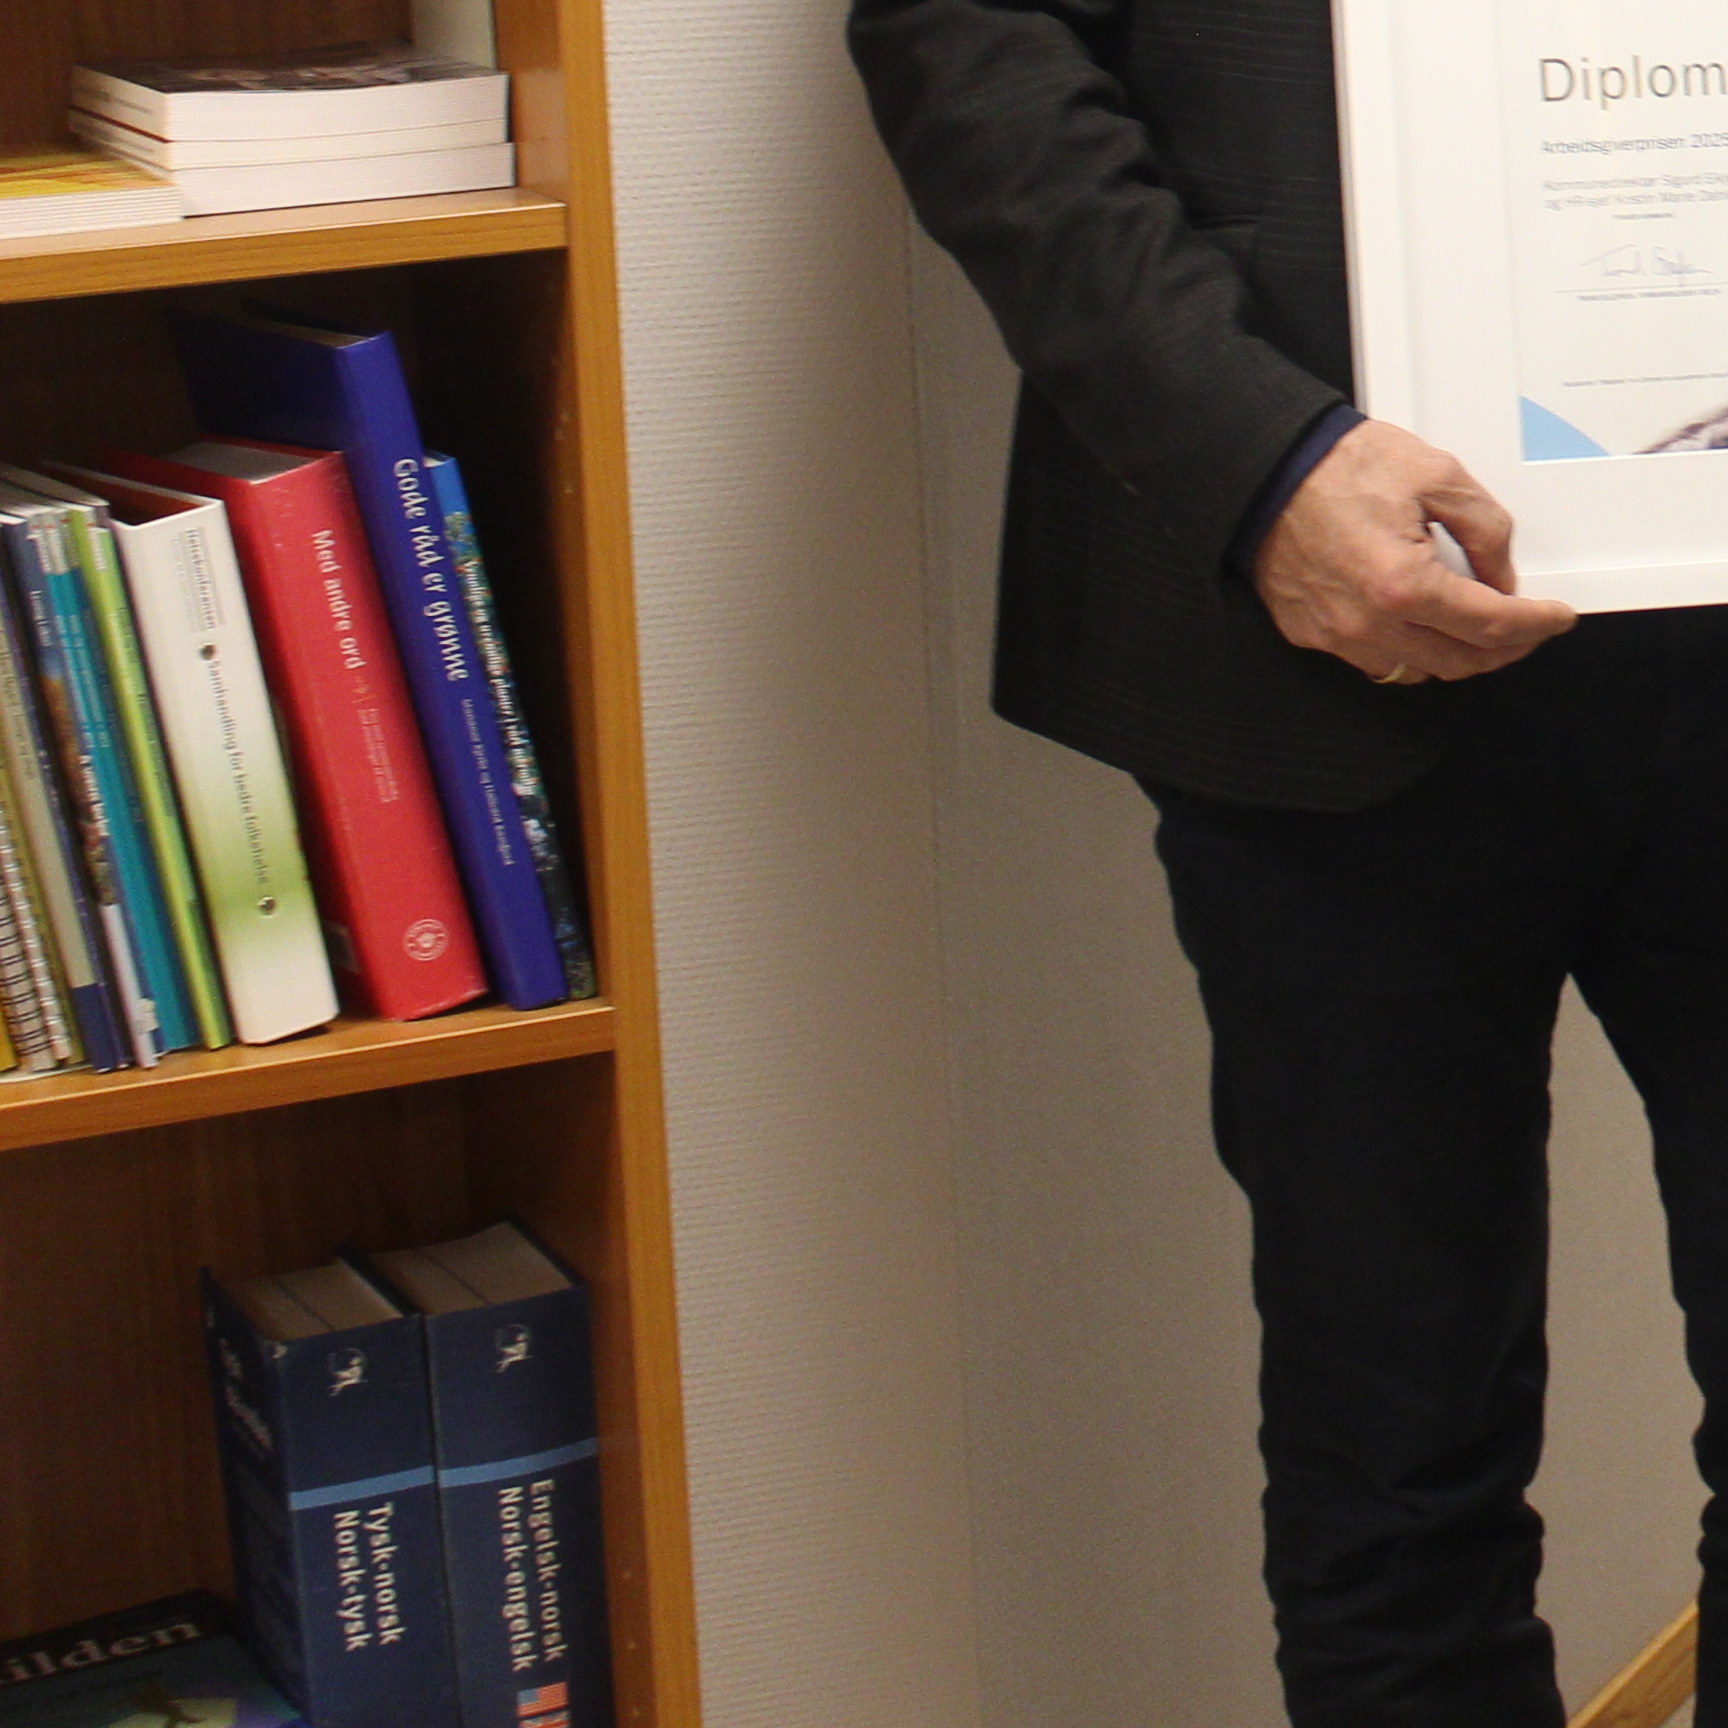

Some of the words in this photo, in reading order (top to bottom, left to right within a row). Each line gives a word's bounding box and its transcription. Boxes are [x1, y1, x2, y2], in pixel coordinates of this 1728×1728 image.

[1539, 55, 1728, 110] Diplom
[394, 457, 427, 520] Gode
[311, 528, 341, 573] Med
[410, 524, 444, 568] råd
[322, 576, 352, 632] andre
[422, 571, 447, 593] er
[338, 635, 366, 670] ord
[423, 600, 468, 682] grønne
[208, 659, 238, 752] Samhandling
[229, 751, 244, 771] for
[333, 1510, 373, 1652] Norsk-tysk
[362, 1501, 407, 1646] Tysk-norsk
[498, 1486, 539, 1672] Norsk-engelsk
[527, 1478, 569, 1663] Engelsk-norsk
[0, 1622, 202, 1686] ilden
